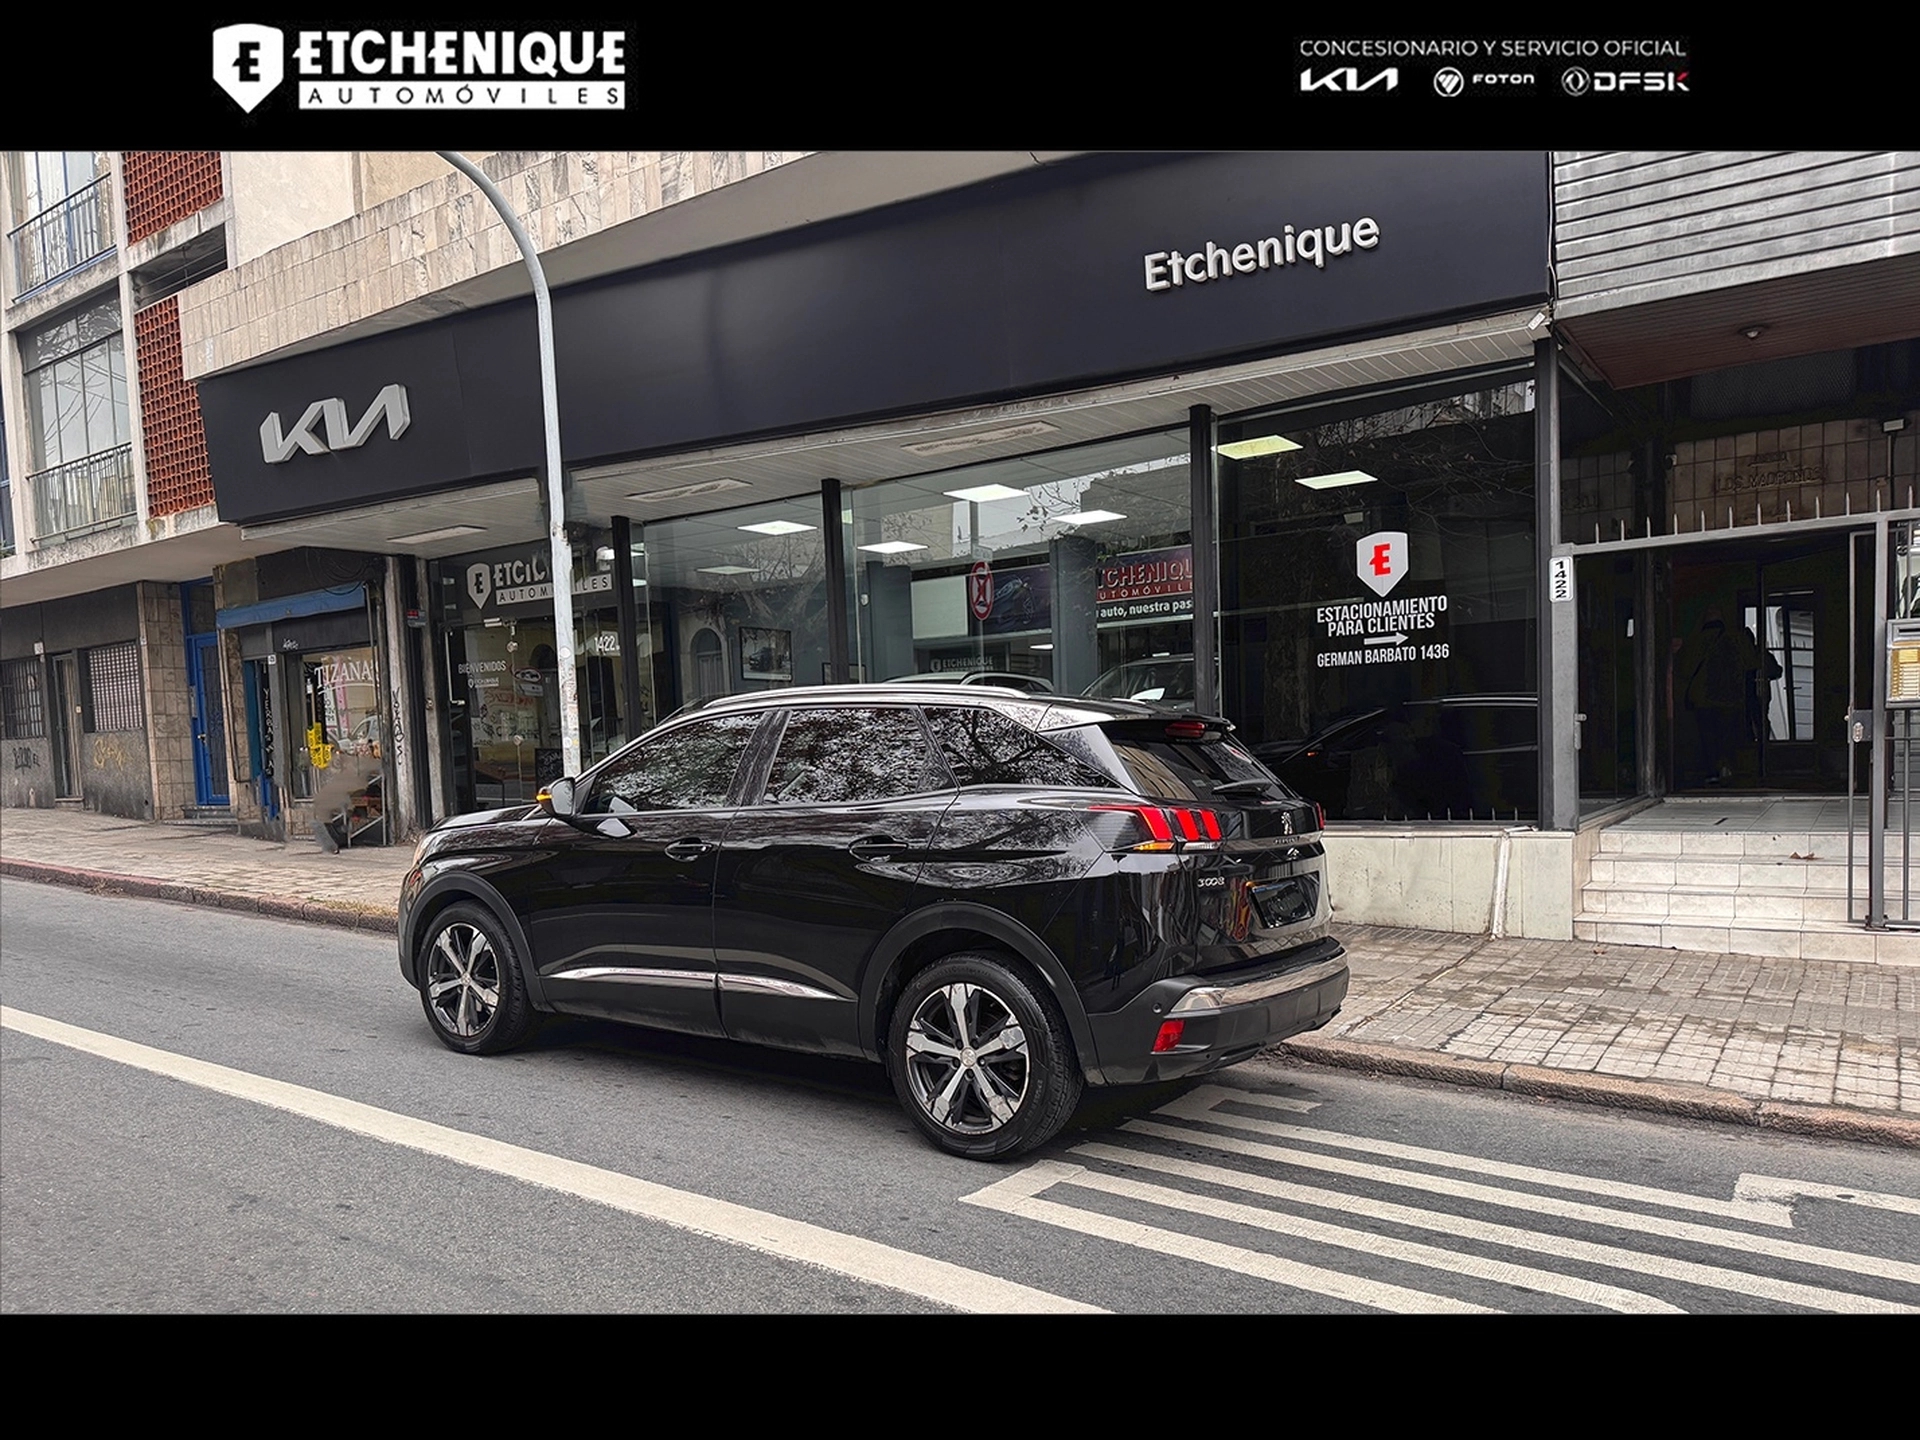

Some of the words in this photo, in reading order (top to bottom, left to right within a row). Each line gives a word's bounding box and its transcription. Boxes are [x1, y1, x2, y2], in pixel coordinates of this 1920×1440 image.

[1144, 217, 1380, 291] Etchenique
[260, 383, 411, 464] KIA
[1554, 560, 1567, 599] 1422
[1100, 605, 1128, 618] auto,
[1129, 601, 1170, 615] nuestra
[1317, 595, 1448, 623] ESTACIONAMIENTO
[1327, 620, 1365, 637] PARA
[1367, 612, 1435, 634] CLIENTES
[457, 660, 507, 674] BIENVENIDOS
[1317, 648, 1362, 667] GERMAN
[1365, 646, 1417, 664] BARBATO
[1420, 644, 1449, 660] 1436
[1197, 877, 1225, 888] 3008
